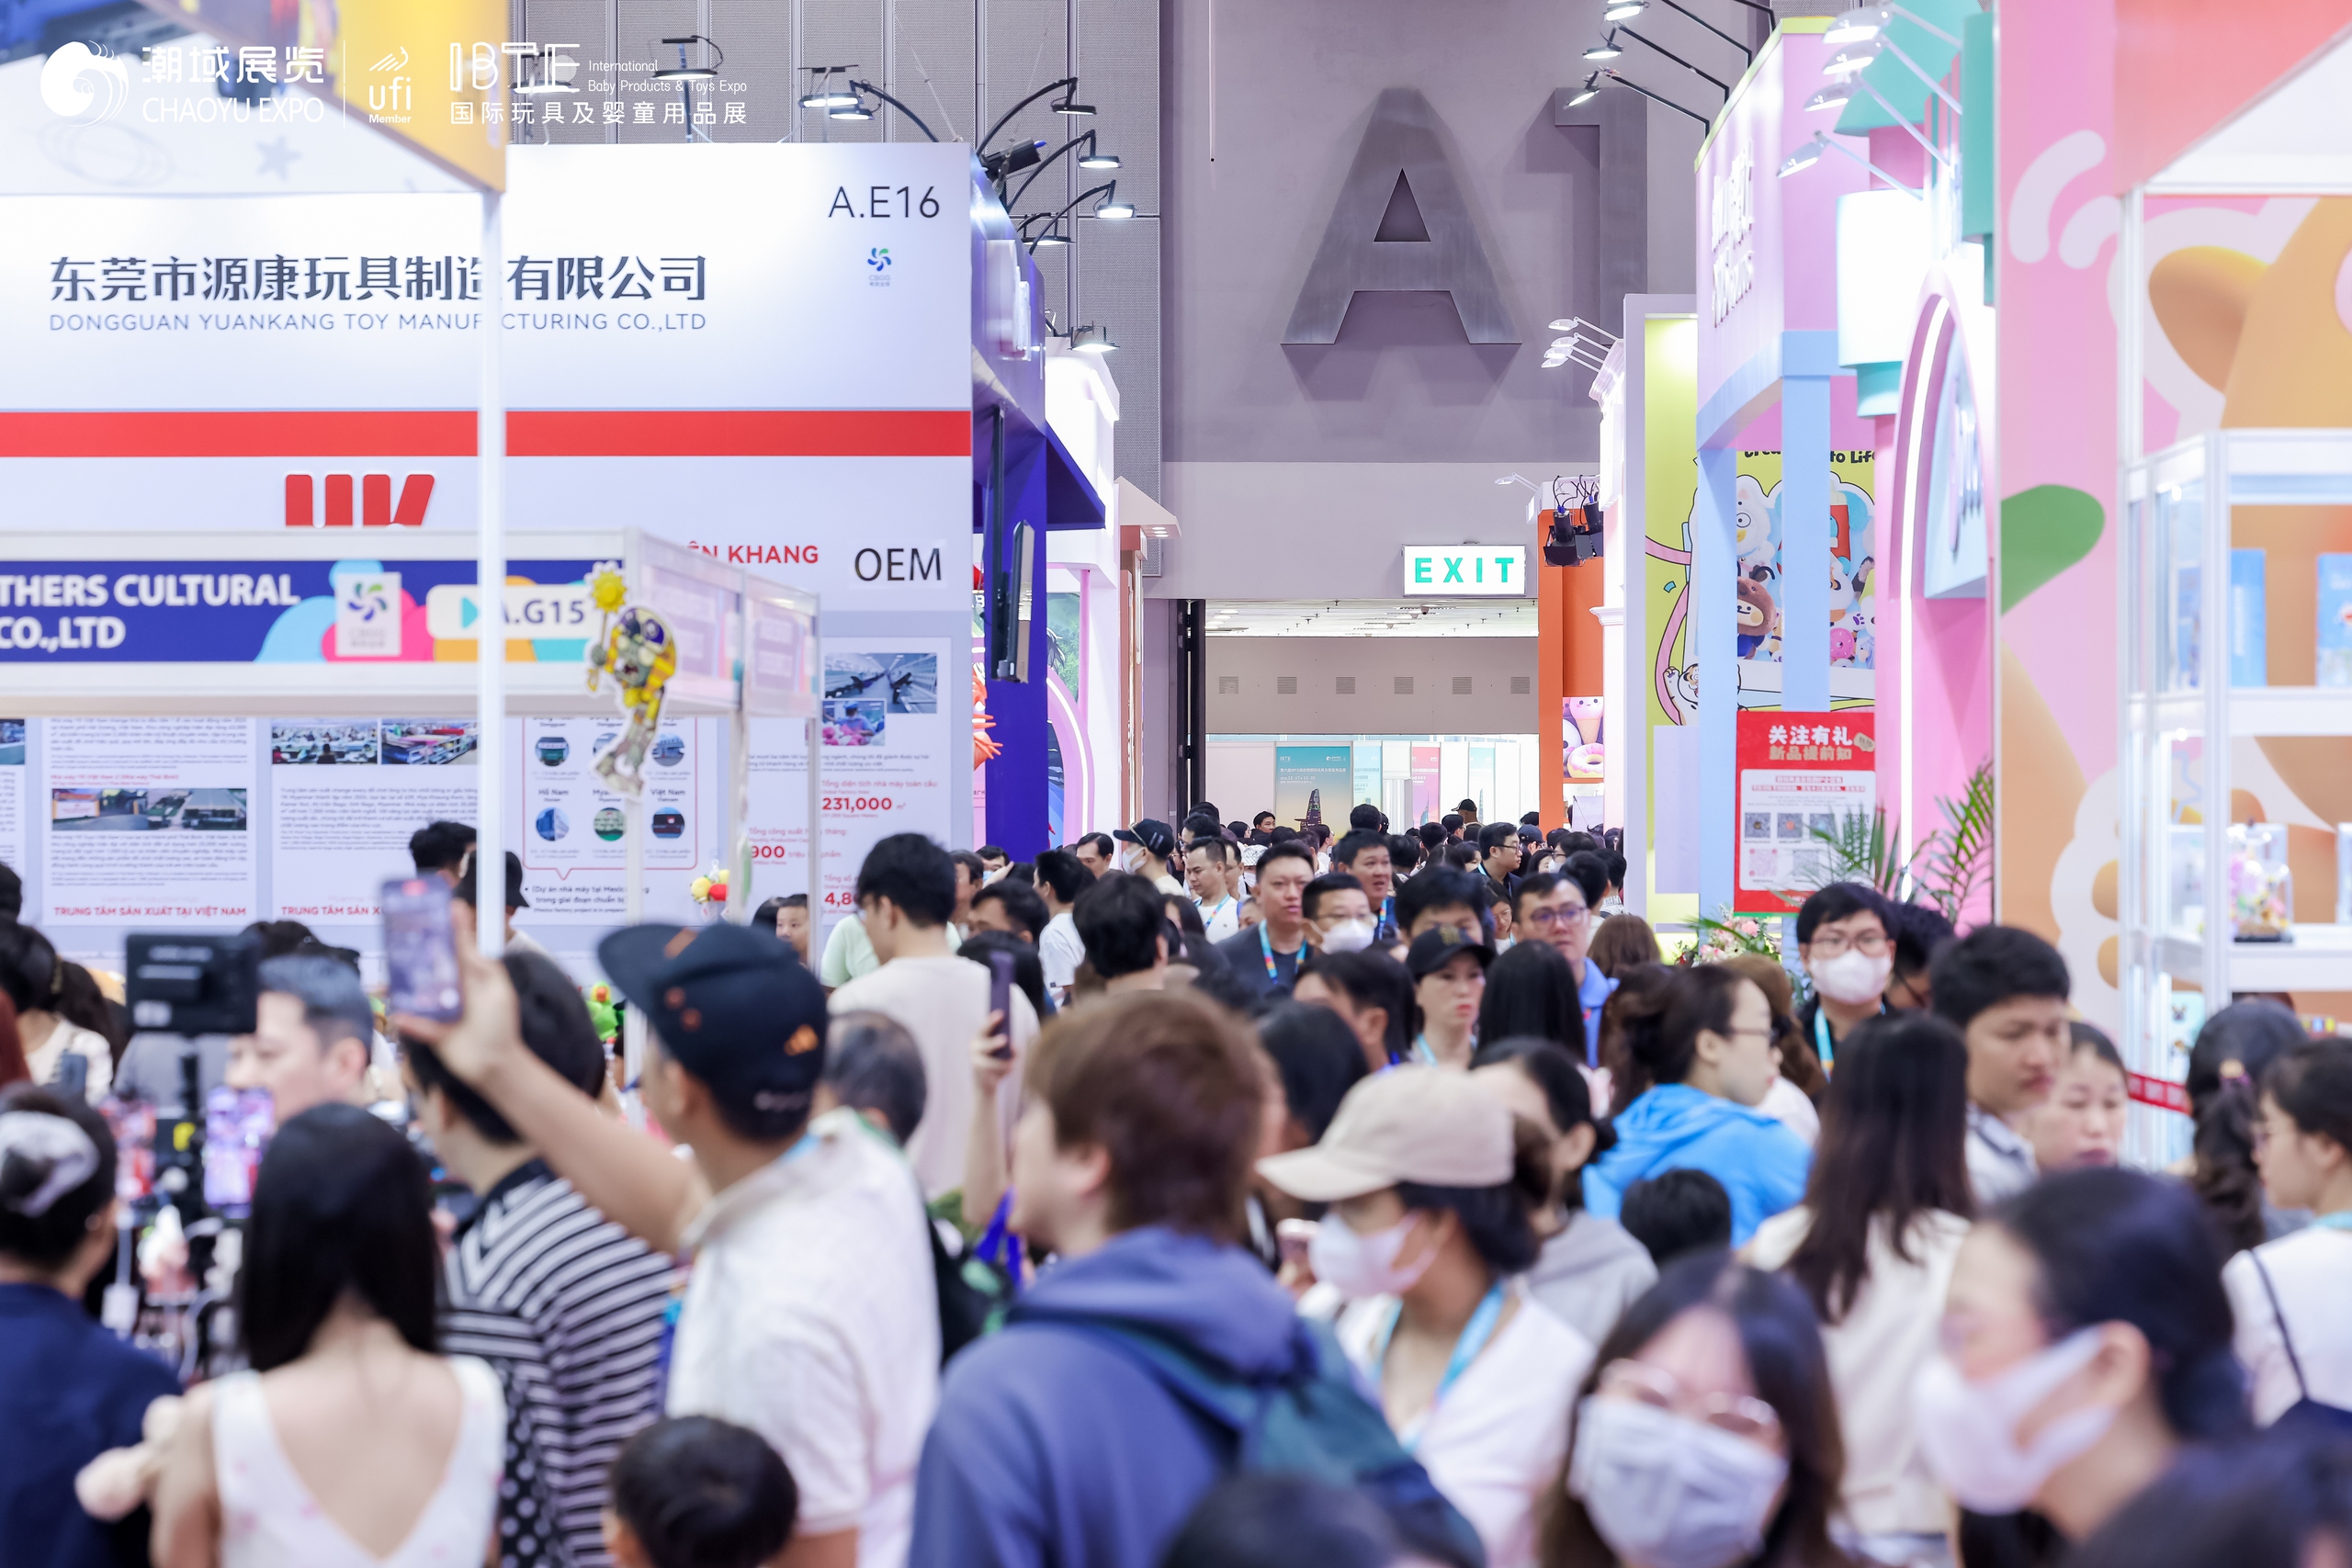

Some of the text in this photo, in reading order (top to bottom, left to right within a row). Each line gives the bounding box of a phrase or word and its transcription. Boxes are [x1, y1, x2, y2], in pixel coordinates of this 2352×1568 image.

[828, 186, 940, 219] A.E16
[49, 313, 707, 333] DONGGUAN YUANKANG TOY MANUFCTURING CO.,LTD
[728, 545, 820, 564] KHANG
[854, 547, 943, 581] OEM
[1415, 558, 1515, 583] EXIT
[113, 573, 302, 607] CULTURAL
[0, 615, 127, 653] CO.,LTD
[1768, 724, 1853, 746] 关注有礼
[821, 797, 893, 813] 231,000
[751, 845, 786, 859] 900
[53, 907, 92, 917] TRUNG
[220, 907, 247, 917] NAM
[281, 906, 320, 916] TRUNG
